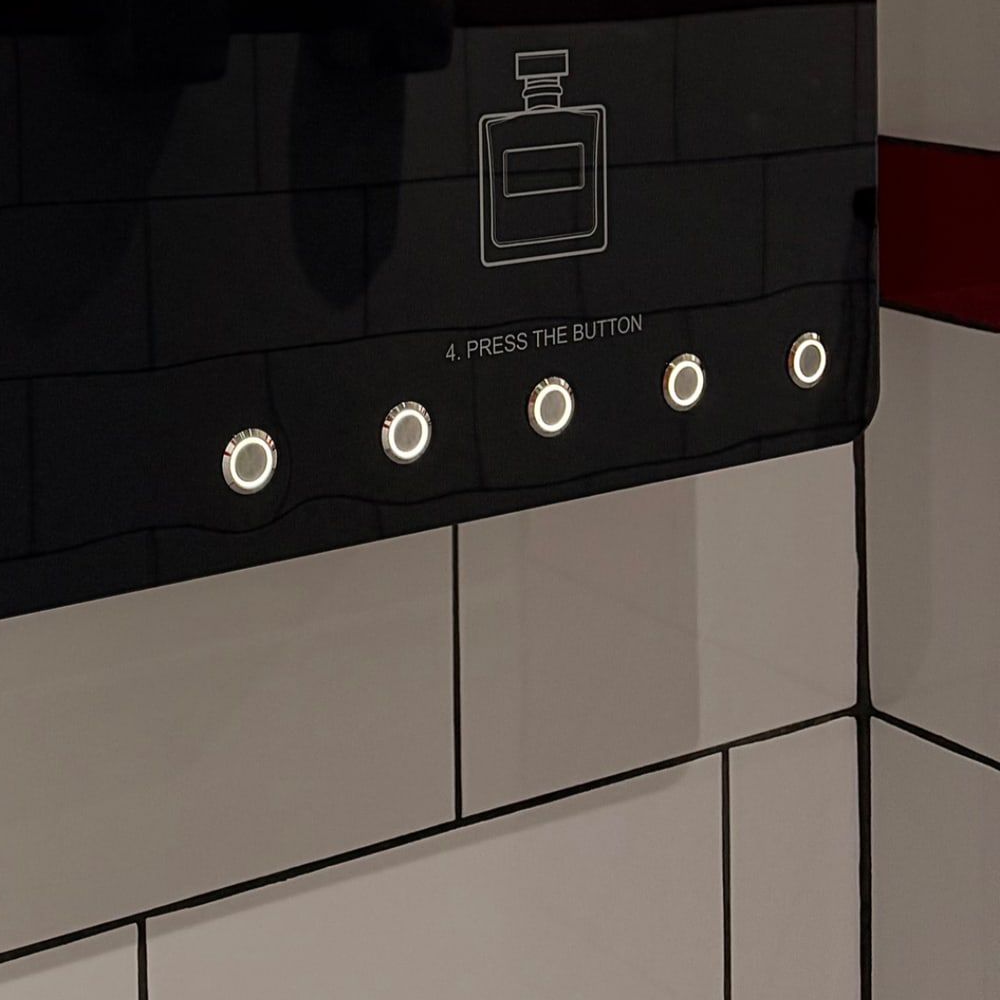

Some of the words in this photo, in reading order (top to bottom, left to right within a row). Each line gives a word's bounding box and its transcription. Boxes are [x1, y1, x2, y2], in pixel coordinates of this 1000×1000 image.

[445, 343, 460, 361] 4.
[467, 332, 528, 359] PRESS
[533, 326, 568, 348] THE
[573, 314, 643, 342] BUTTON
